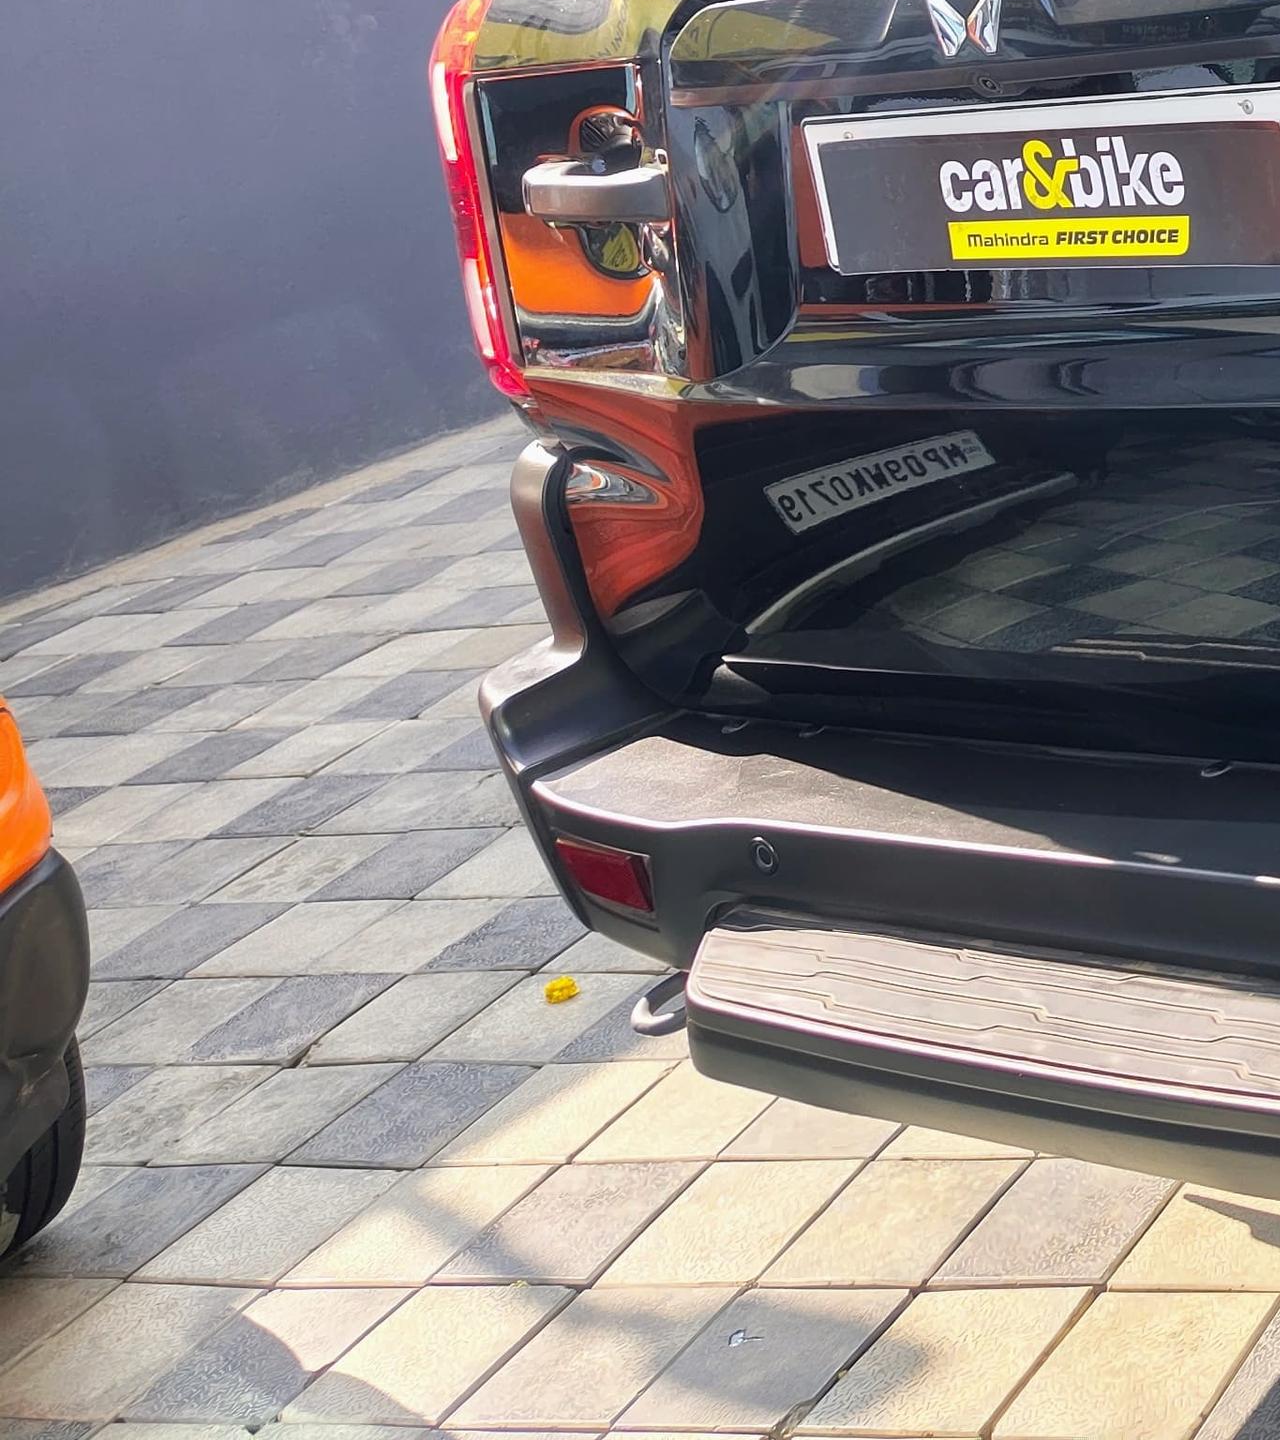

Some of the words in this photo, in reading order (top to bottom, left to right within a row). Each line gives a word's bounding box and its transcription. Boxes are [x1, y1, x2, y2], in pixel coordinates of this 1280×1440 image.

[940, 135, 1186, 213] car&bike
[967, 233, 1050, 248] Mahindra
[1055, 230, 1110, 246] FIRST
[1111, 228, 1180, 245] CHOICE
